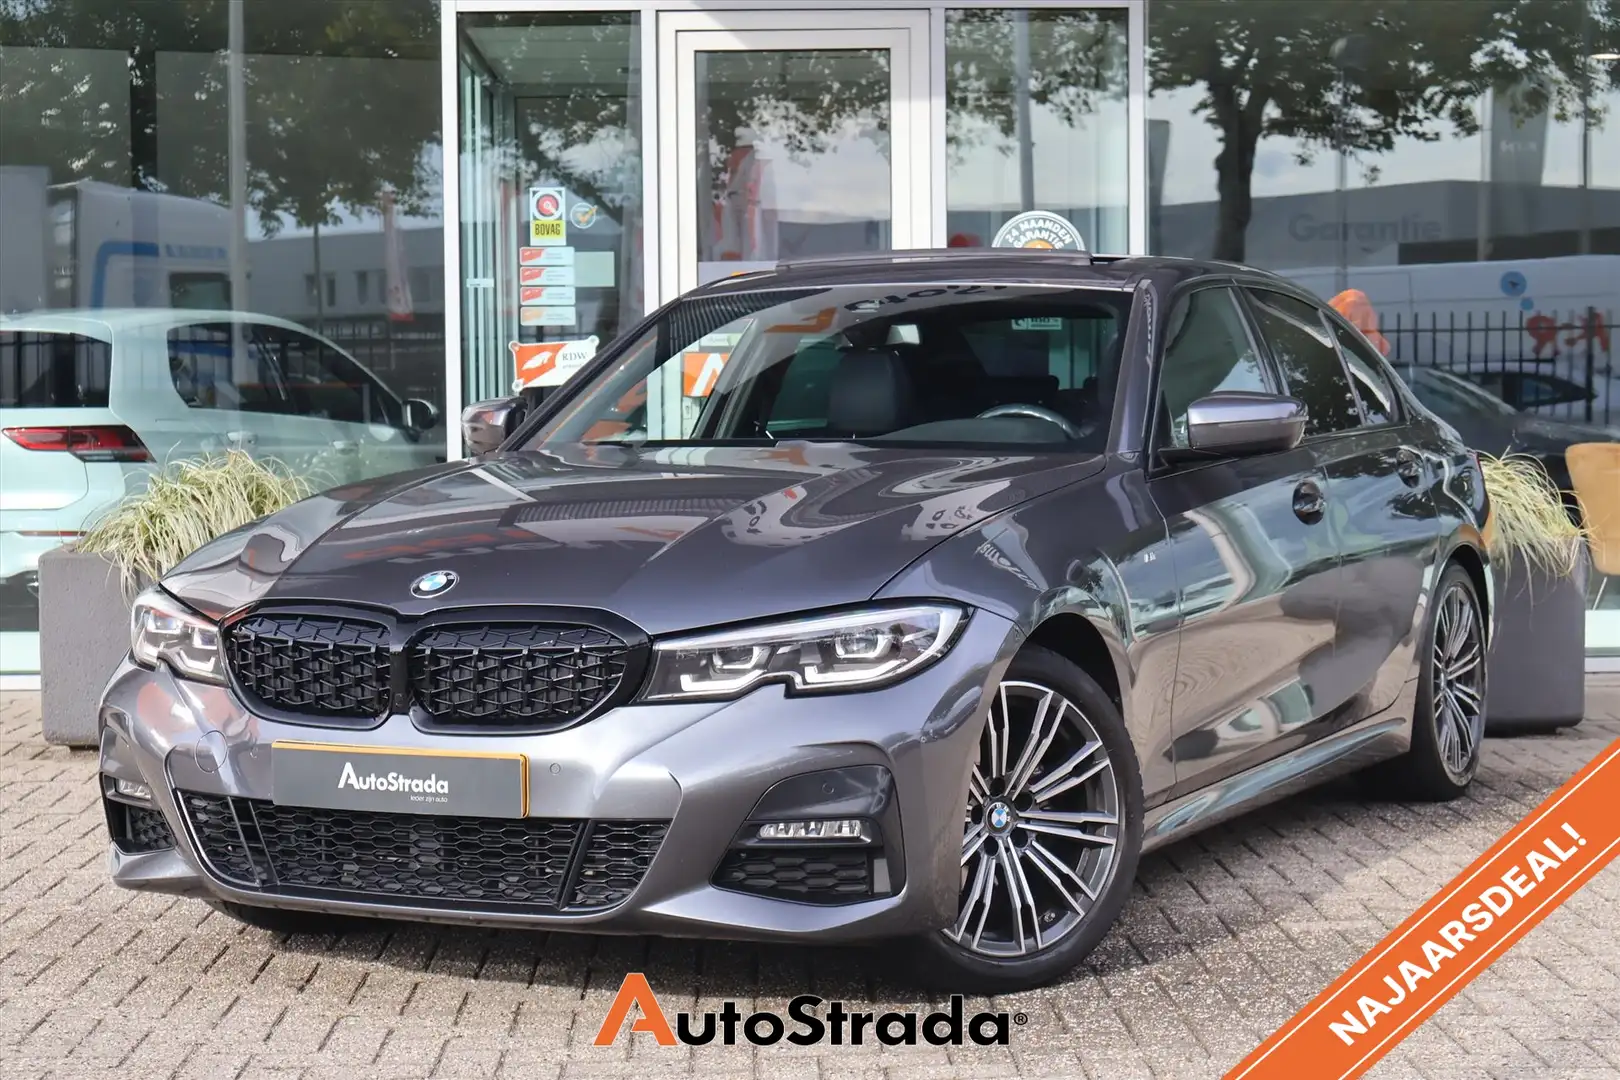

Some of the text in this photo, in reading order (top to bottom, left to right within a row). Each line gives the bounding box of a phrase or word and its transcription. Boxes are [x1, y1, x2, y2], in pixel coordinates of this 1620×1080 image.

[535, 223, 561, 236] BOVAG
[1005, 218, 1073, 245] 24 MAANDEN
[1013, 230, 1064, 249] GARANTIE
[562, 352, 588, 361] RDW
[337, 761, 449, 794] AutoStrada
